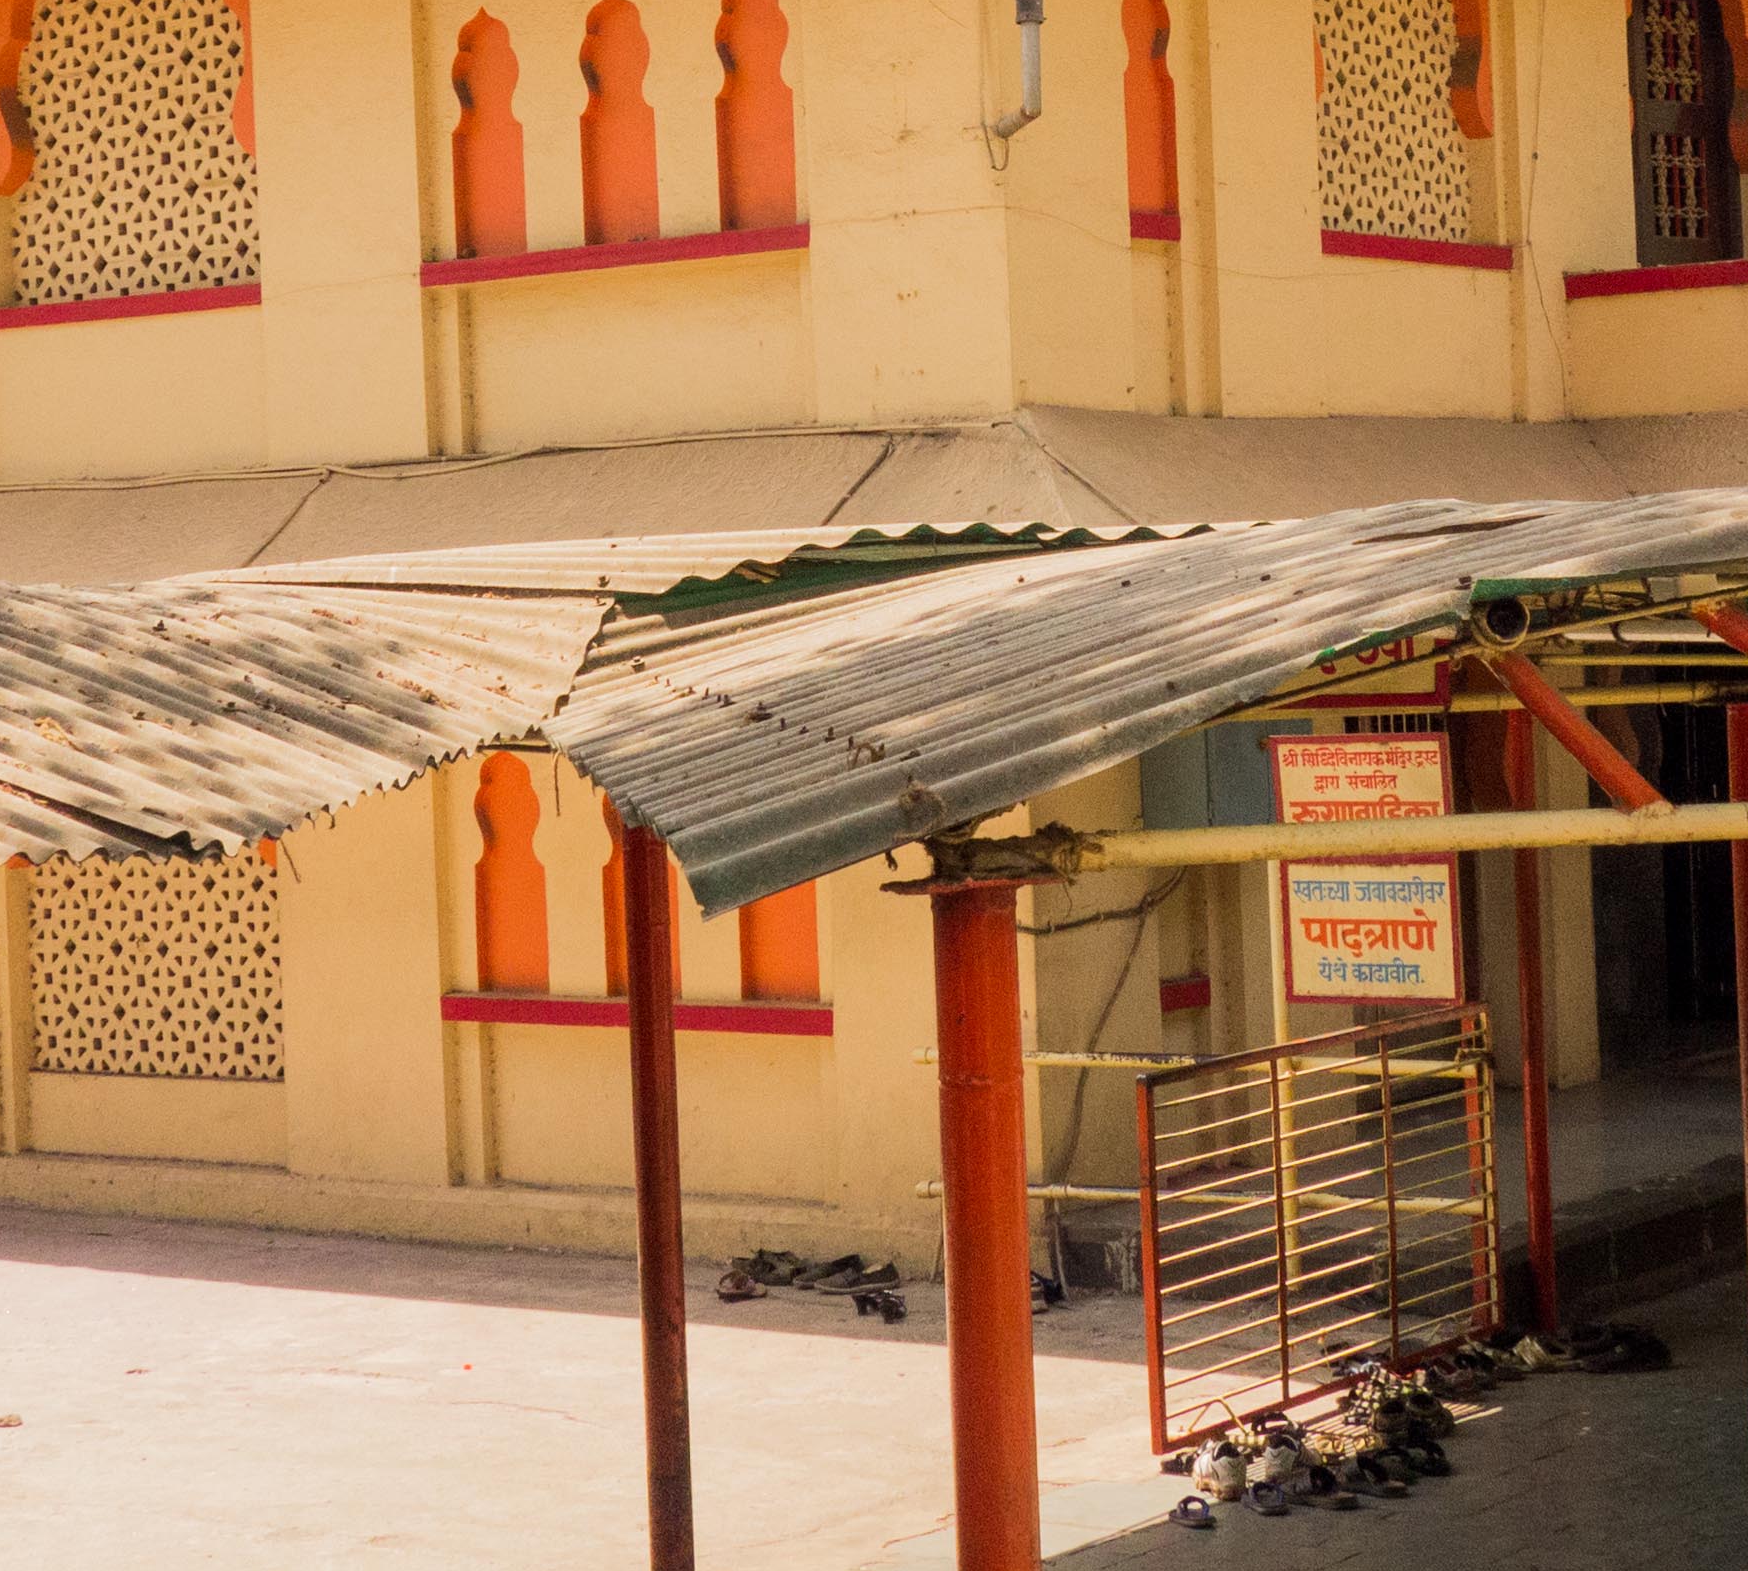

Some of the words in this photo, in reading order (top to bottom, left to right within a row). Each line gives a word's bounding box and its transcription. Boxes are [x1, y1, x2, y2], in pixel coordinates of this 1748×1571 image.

[1282, 749, 1298, 767] श्री
[1384, 746, 1413, 769] मंदिर
[1345, 770, 1398, 790] संचालित
[1319, 956, 1348, 982] येथे
